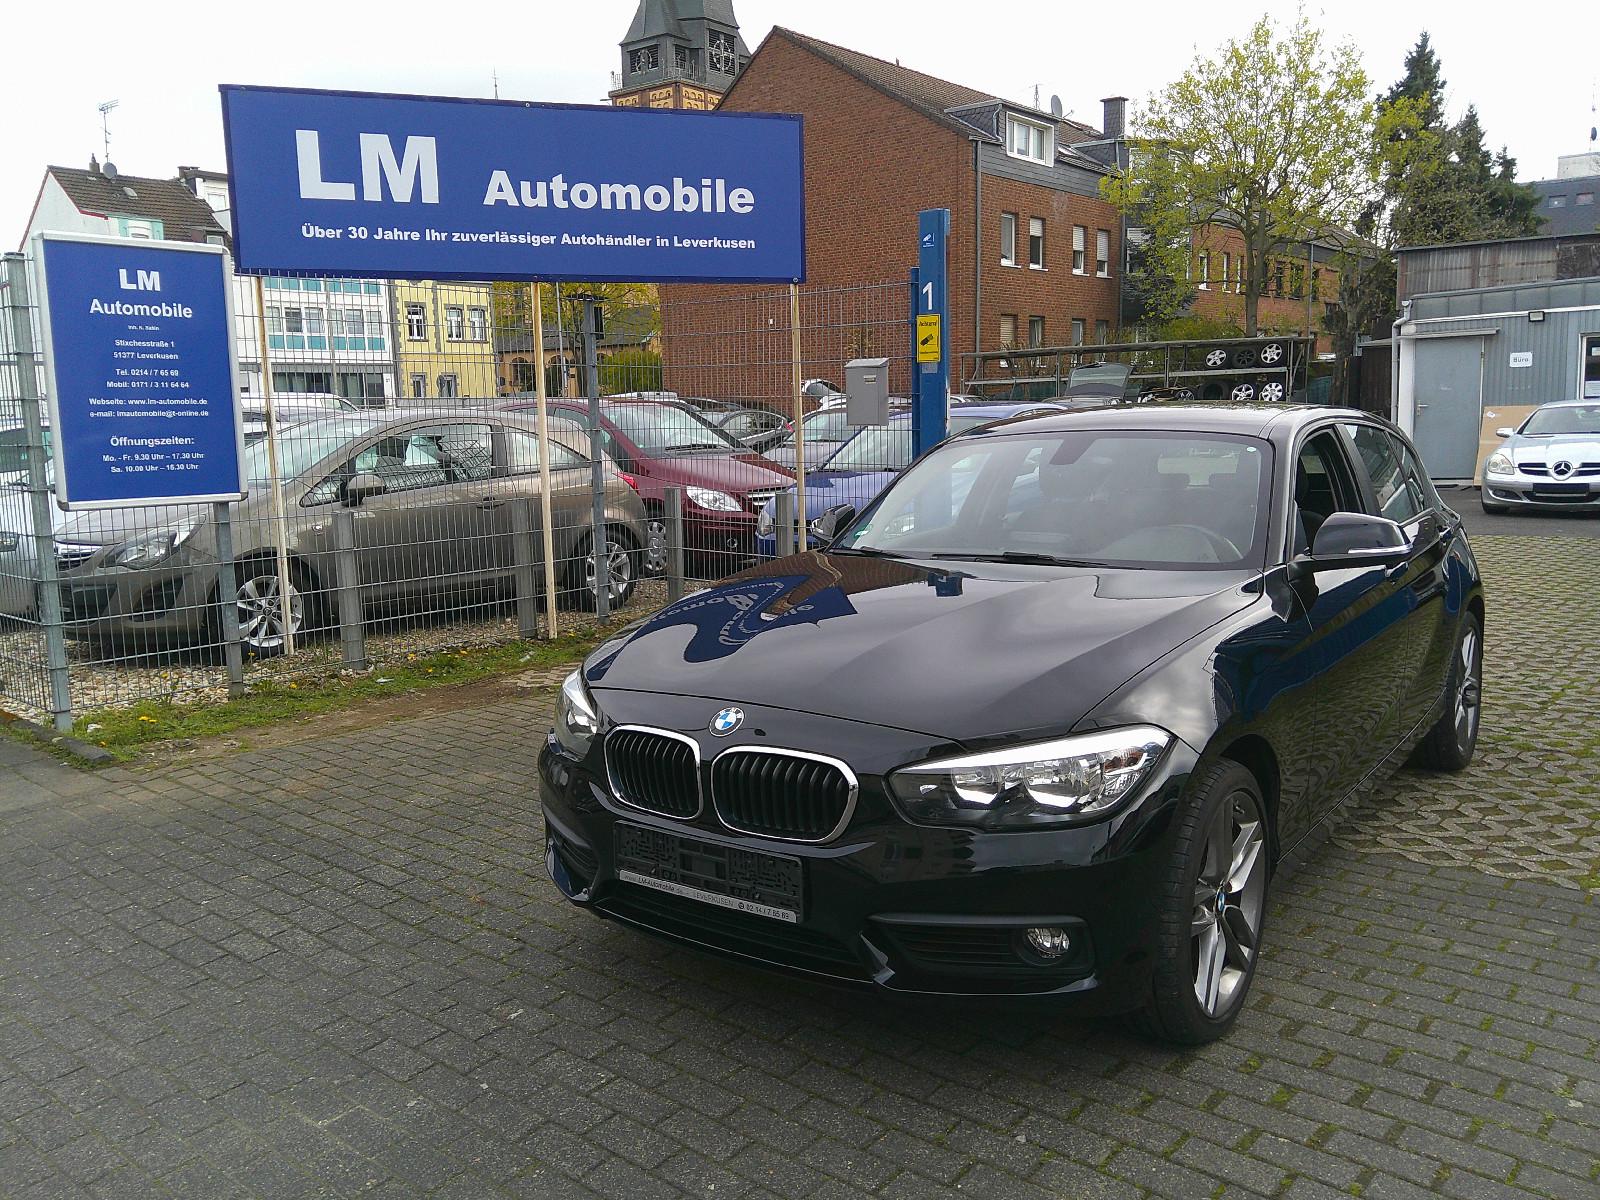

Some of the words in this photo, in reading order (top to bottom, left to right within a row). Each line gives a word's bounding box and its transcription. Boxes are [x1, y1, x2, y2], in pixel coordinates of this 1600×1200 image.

[296, 130, 439, 204] LM
[483, 170, 754, 214] Automobile
[302, 222, 342, 240] Über
[348, 226, 368, 240] 30
[374, 226, 420, 242] Jahre
[425, 229, 447, 242] Ihr
[452, 230, 556, 247] zuverlässiger
[561, 232, 652, 248] Autohändler
[657, 234, 669, 248] in
[674, 235, 755, 250] Leverkusen
[119, 268, 160, 291] LM
[90, 298, 193, 318] Automobile
[922, 281, 933, 310] 1
[110, 436, 194, 447] Öffnungszeiten:
